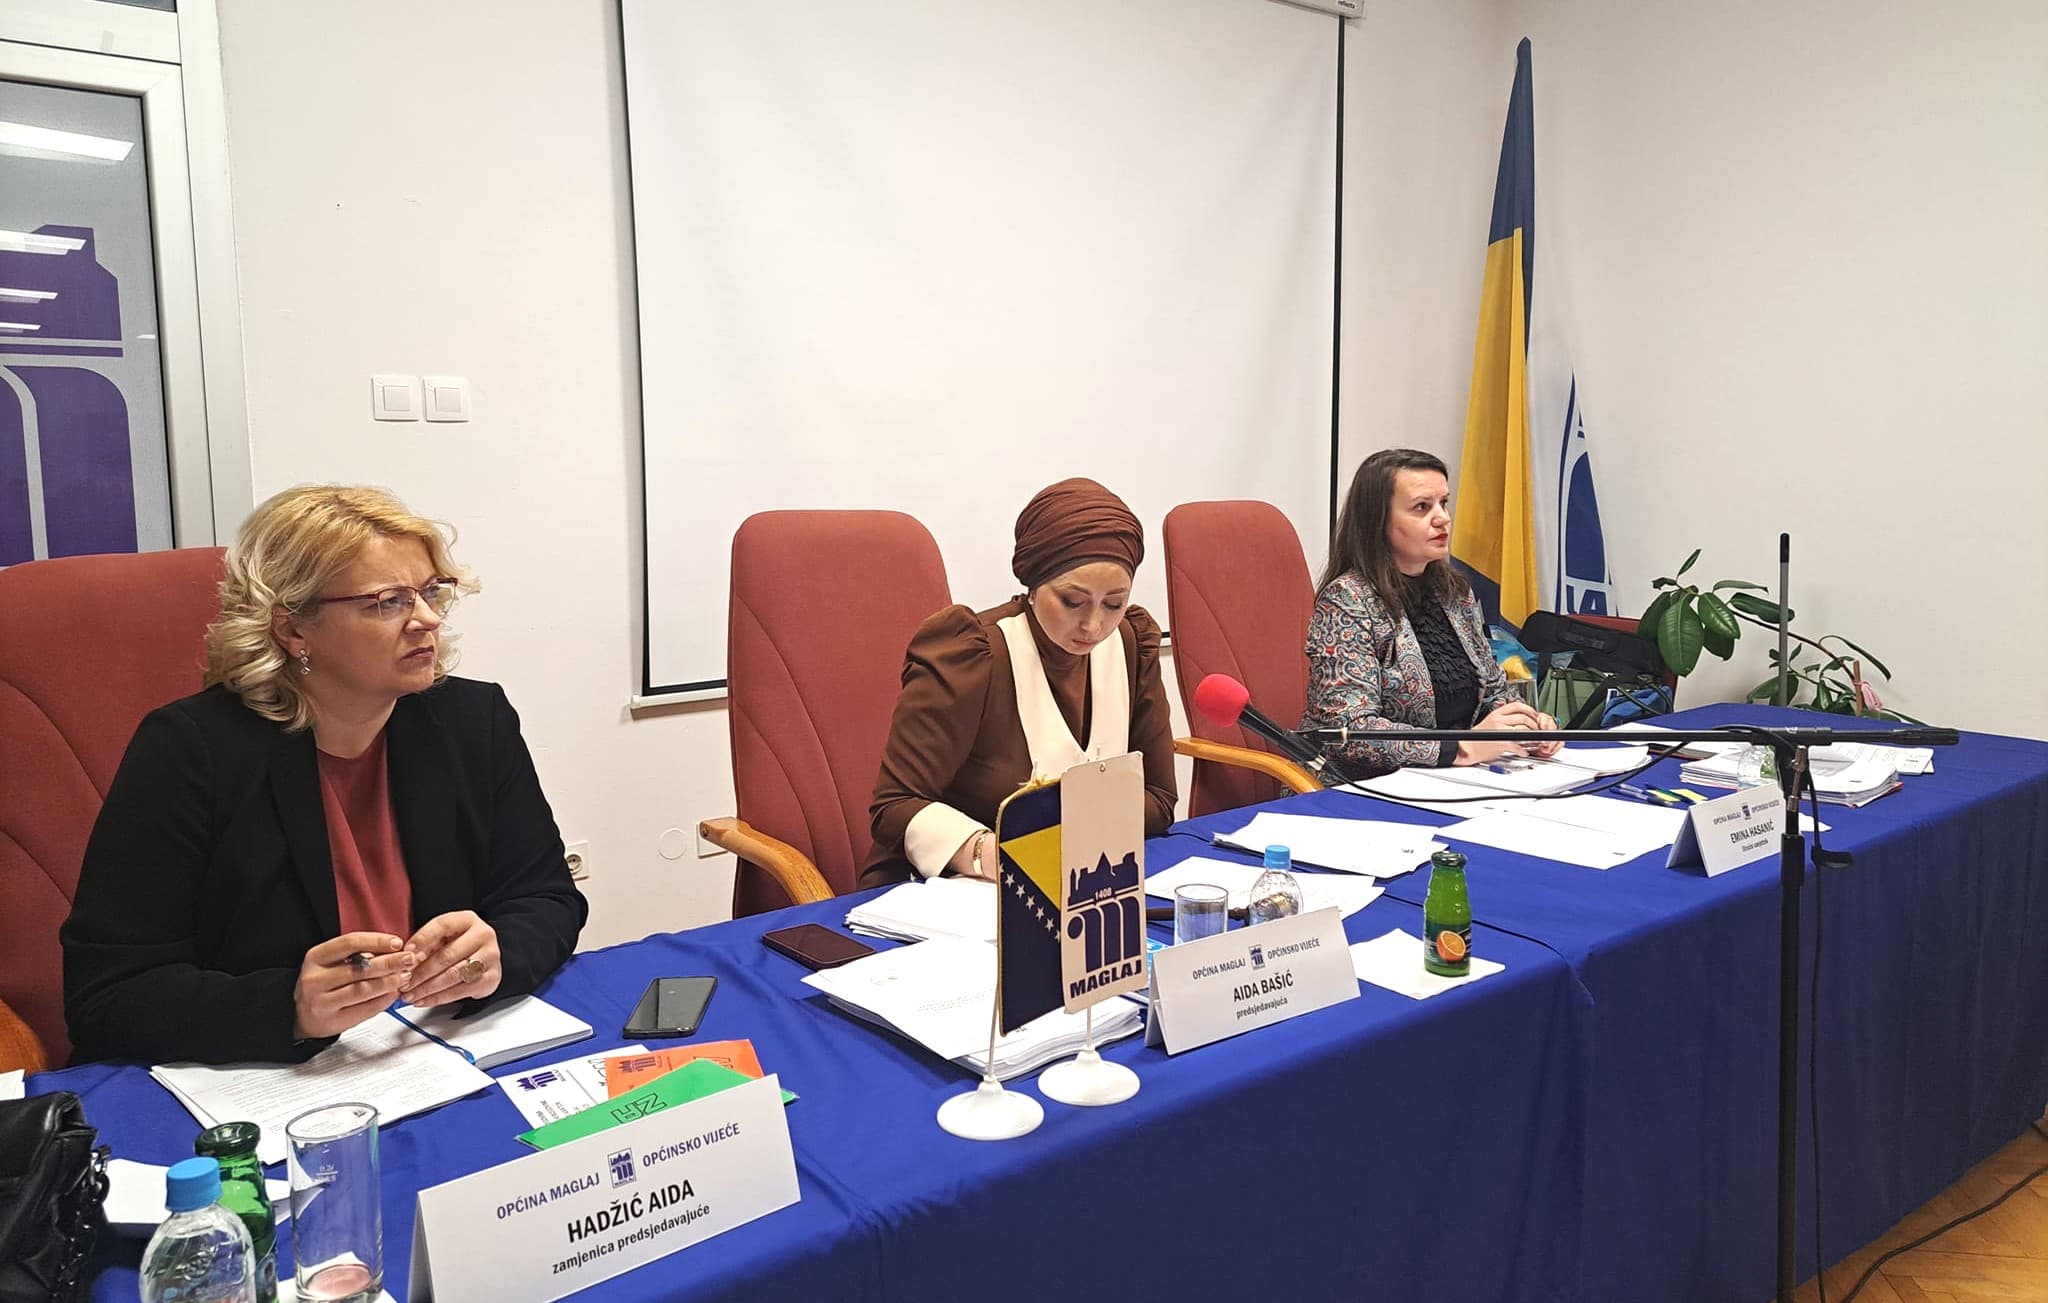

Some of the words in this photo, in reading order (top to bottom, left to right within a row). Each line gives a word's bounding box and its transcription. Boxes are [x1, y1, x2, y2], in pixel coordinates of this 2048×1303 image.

[1730, 829, 1750, 843] EMINA
[1069, 959, 1142, 999] MAGLAJ
[1192, 965, 1219, 980] OPĆINA
[1220, 958, 1246, 973] MAGLAJ
[1267, 944, 1300, 960] OPĆINSKO
[1300, 938, 1320, 951] VIJEĆE
[1233, 982, 1260, 1003] AIDA
[1261, 970, 1294, 994] BAŠIĆ
[1236, 996, 1288, 1020] predsjedavajuća
[496, 1193, 548, 1220] OPĆINA
[550, 1172, 600, 1198] MAGLAJ
[642, 1136, 701, 1168] OPĆINSKO
[703, 1122, 740, 1150] VIJEĆE
[567, 1194, 644, 1243] HADŽIĆ
[648, 1179, 695, 1213] AIDA
[552, 1241, 615, 1274] zamjenica
[617, 1204, 710, 1252] predsjedavajuće
